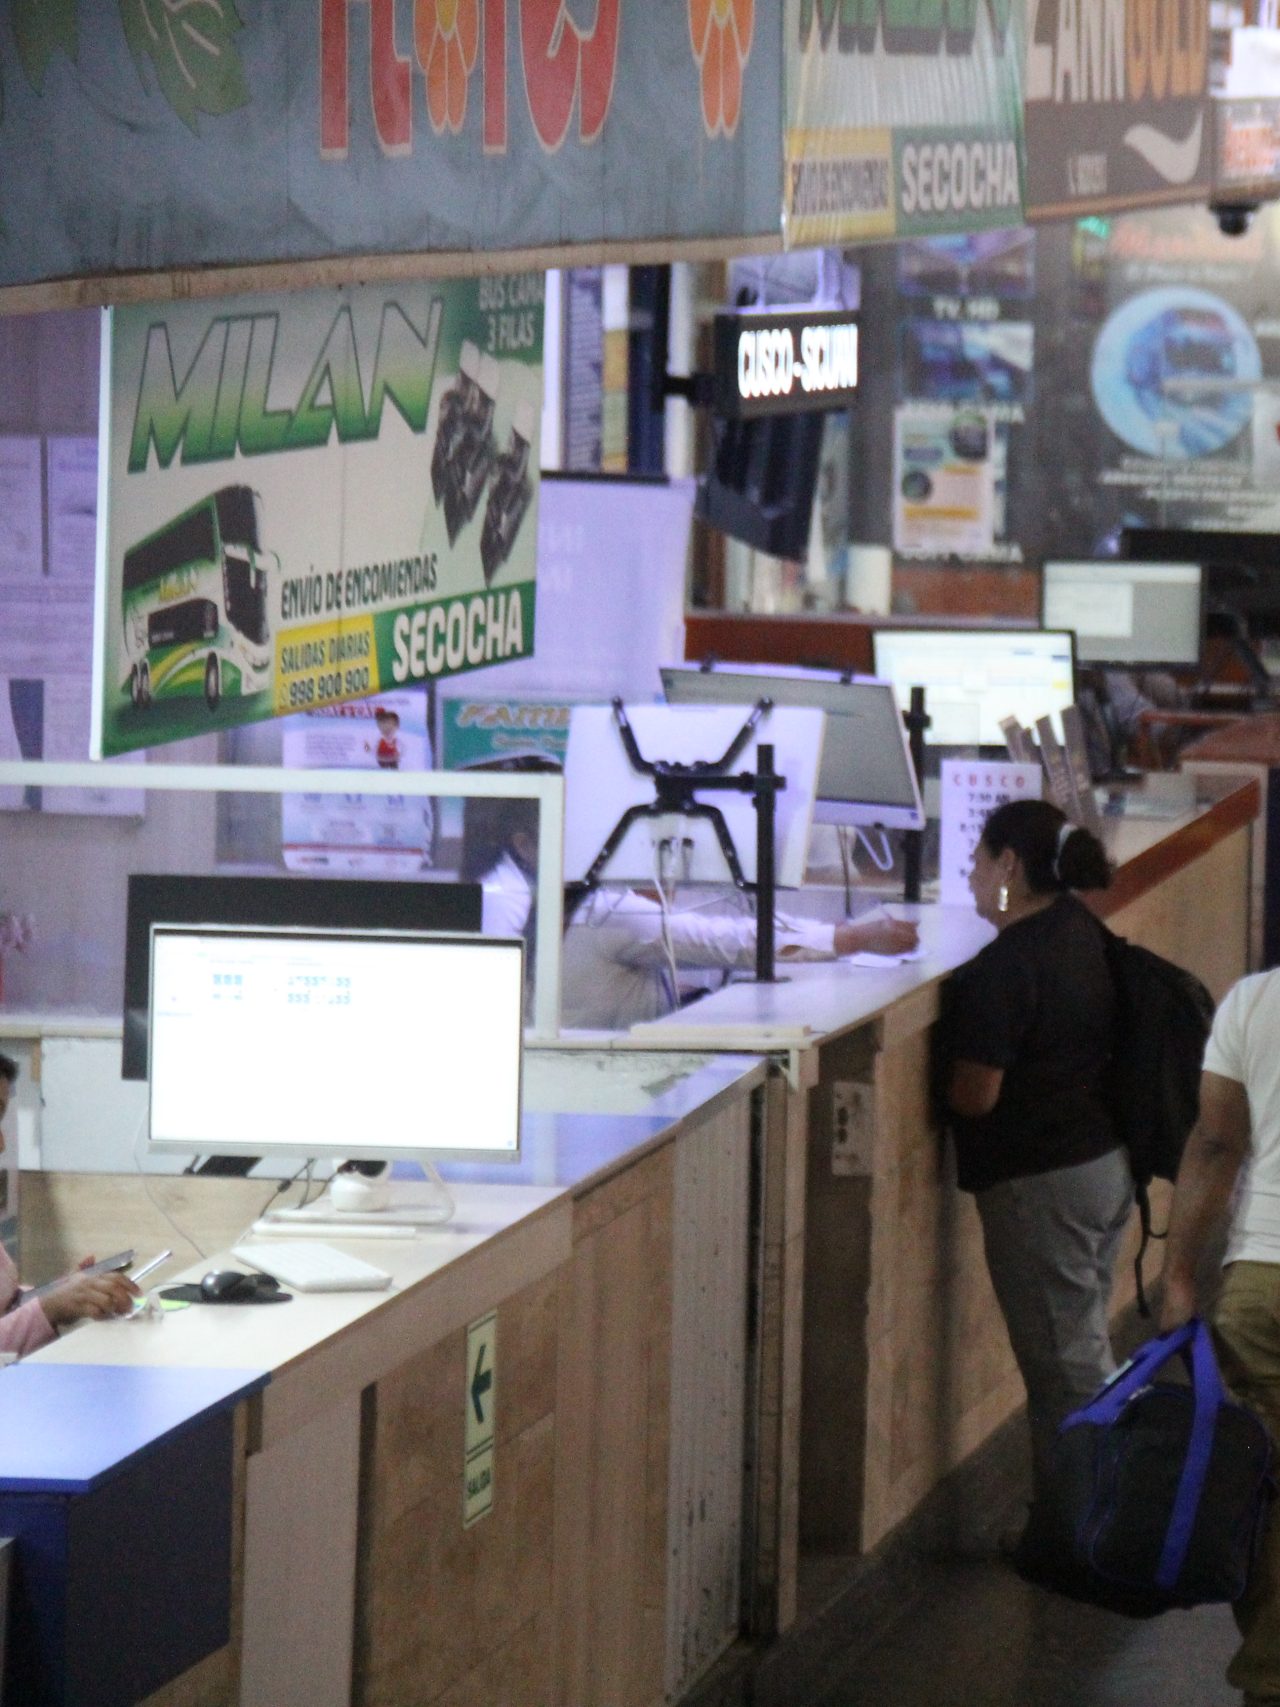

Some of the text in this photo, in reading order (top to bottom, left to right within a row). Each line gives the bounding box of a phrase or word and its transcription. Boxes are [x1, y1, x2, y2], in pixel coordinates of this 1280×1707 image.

[902, 139, 1021, 214] SECOCHA
[128, 297, 444, 475] MILAN
[326, 570, 343, 611] DE
[345, 552, 438, 609] ENCOMIENDAS
[280, 630, 370, 675] SALIDAS DIARIAS
[391, 590, 524, 683] SECOCHA
